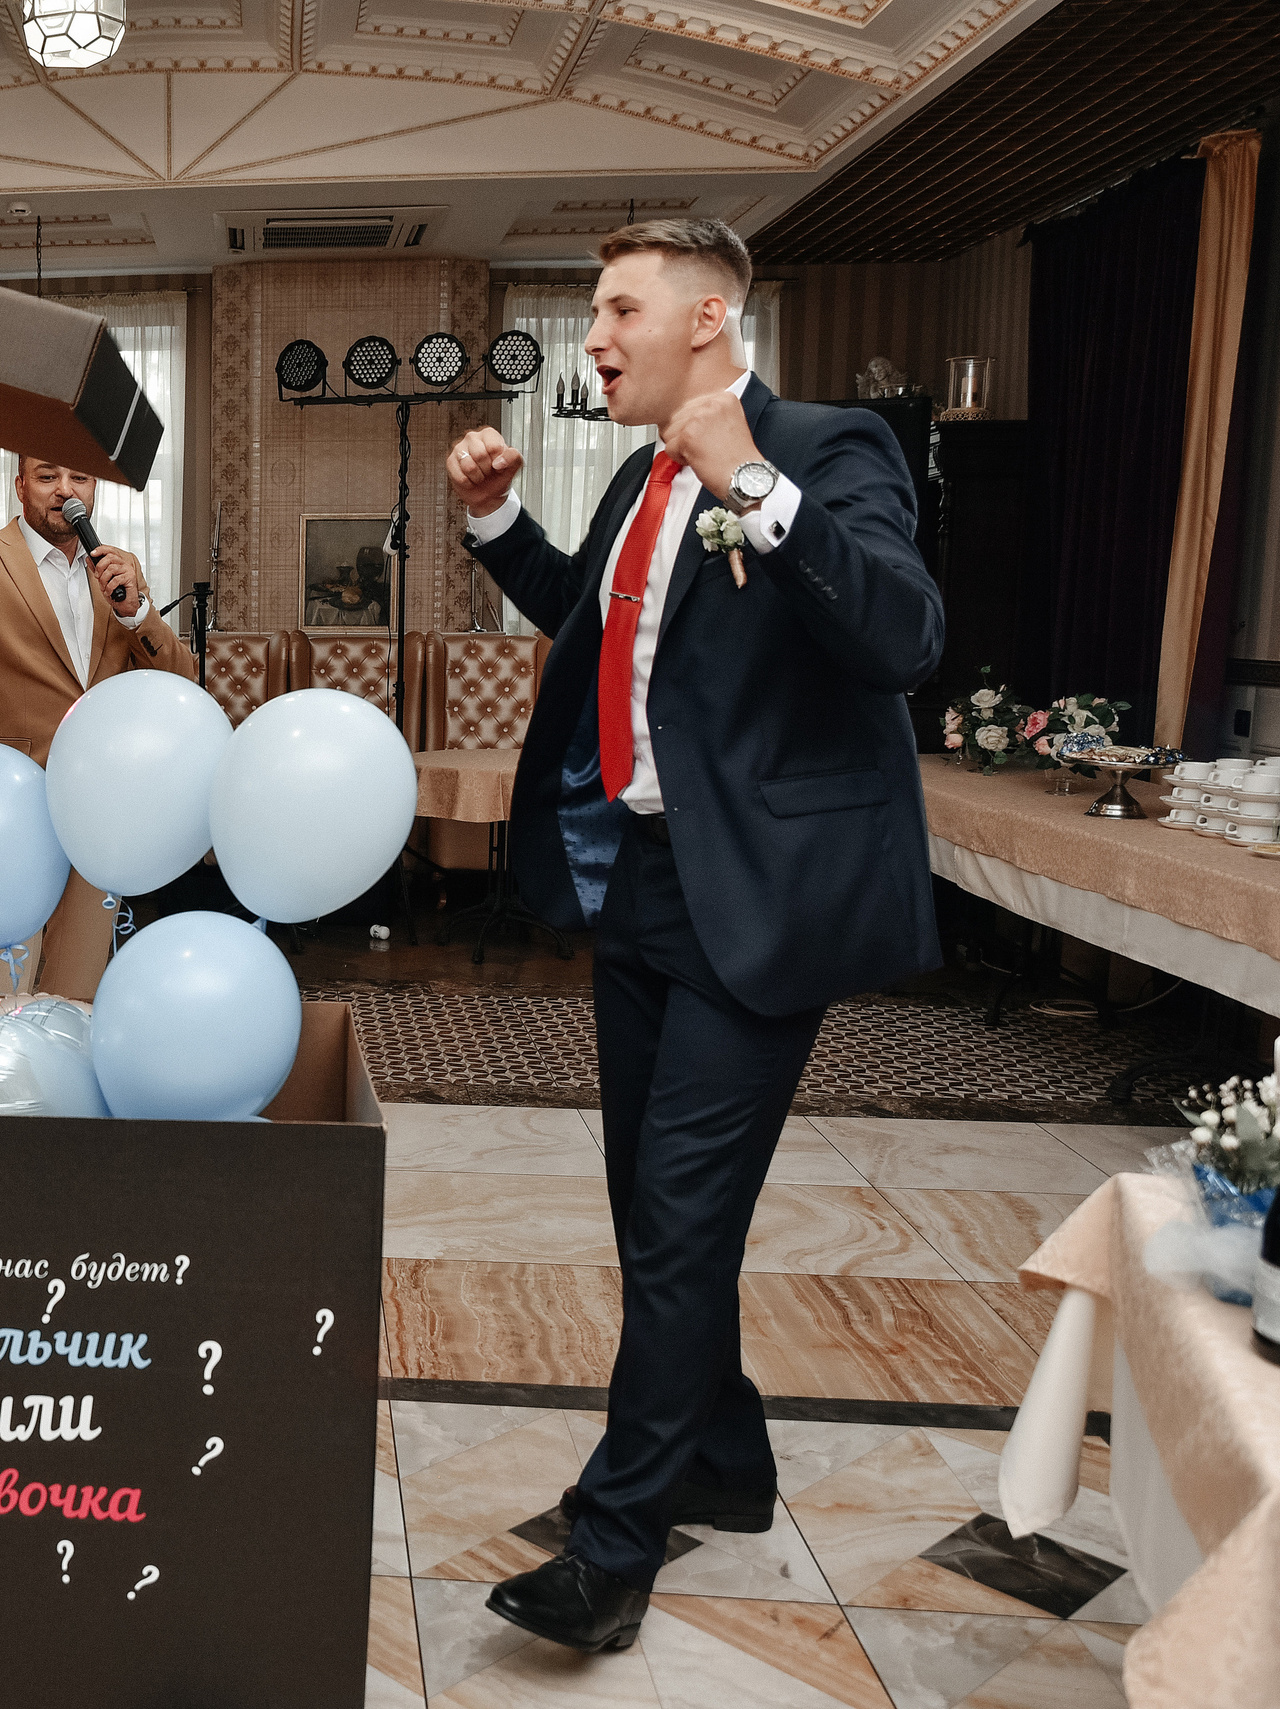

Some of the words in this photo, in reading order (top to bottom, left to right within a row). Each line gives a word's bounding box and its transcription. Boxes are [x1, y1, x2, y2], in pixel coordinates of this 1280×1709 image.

[41, 1278, 66, 1325] ?
[312, 1308, 335, 1356] ?
[197, 1340, 223, 1396] ?
[191, 1436, 225, 1476] ?
[56, 1539, 75, 1584] ?
[126, 1564, 160, 1601] ?
